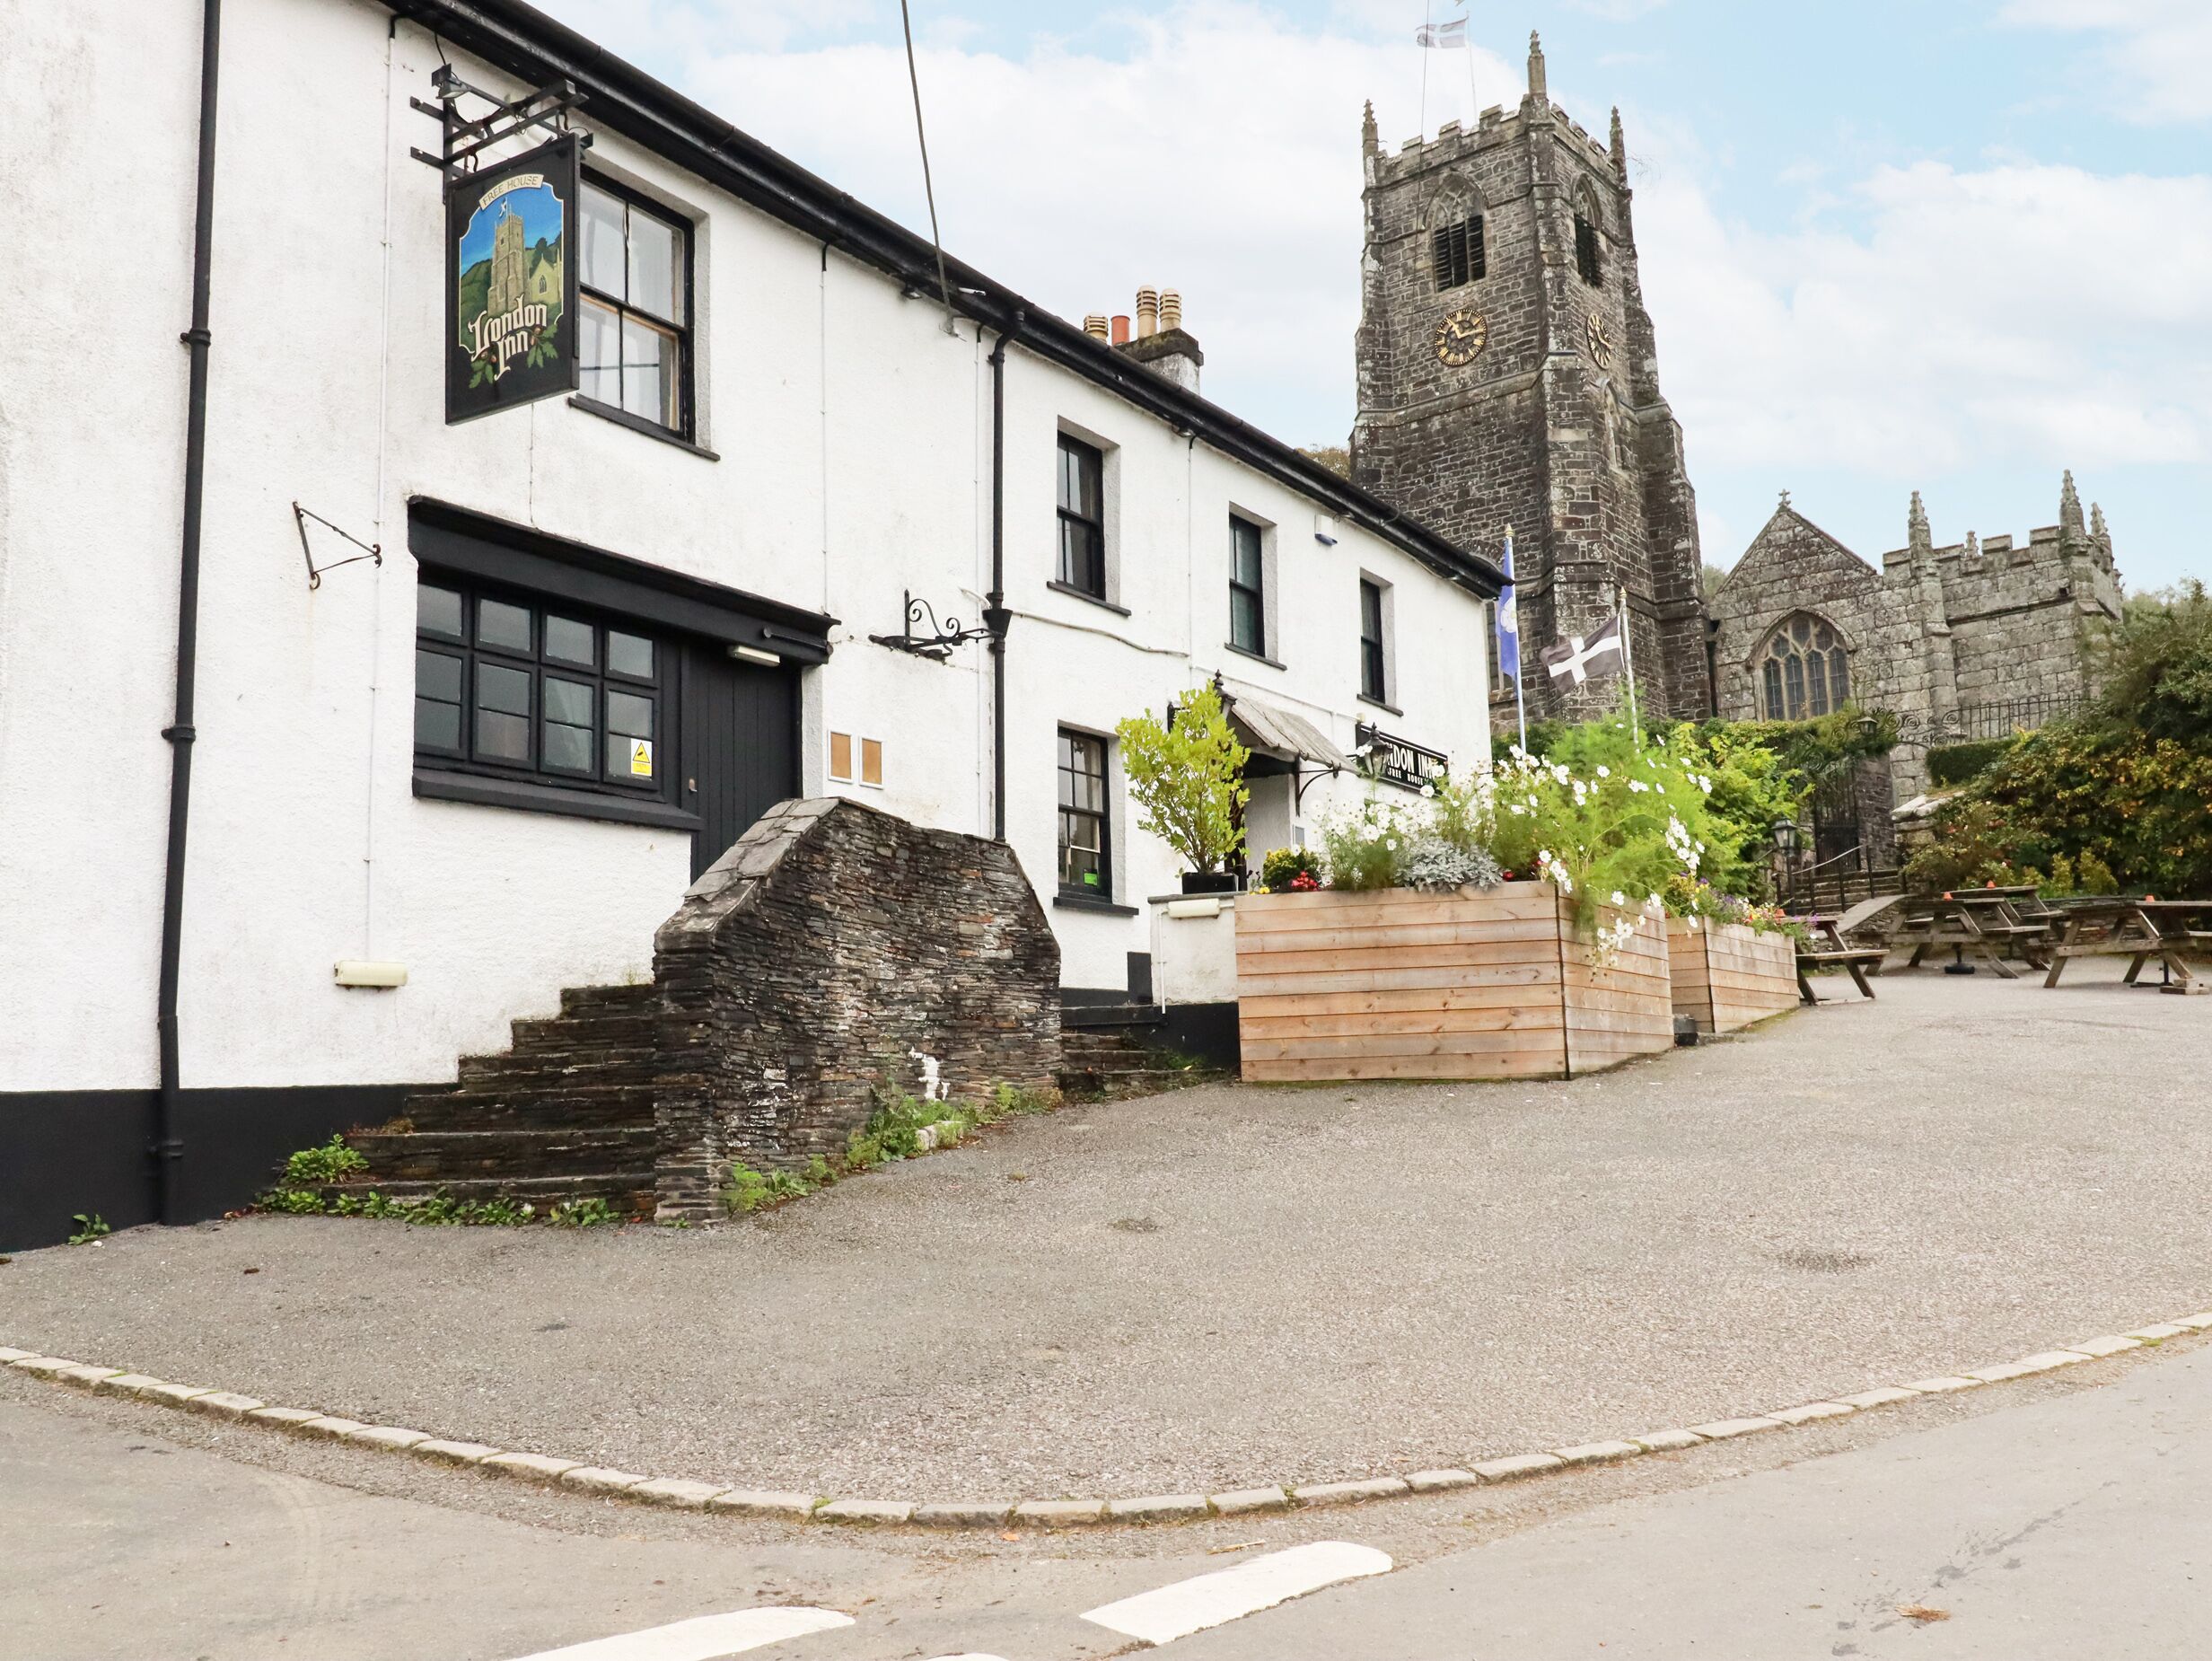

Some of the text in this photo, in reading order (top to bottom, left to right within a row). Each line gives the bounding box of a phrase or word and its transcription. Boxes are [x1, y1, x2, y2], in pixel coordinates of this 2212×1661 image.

[482, 175, 540, 206] FREE HOUSE
[468, 294, 548, 362] London
[494, 330, 529, 381] Inn
[1385, 742, 1416, 774] NDON
[1407, 773, 1424, 786] HOUSE
